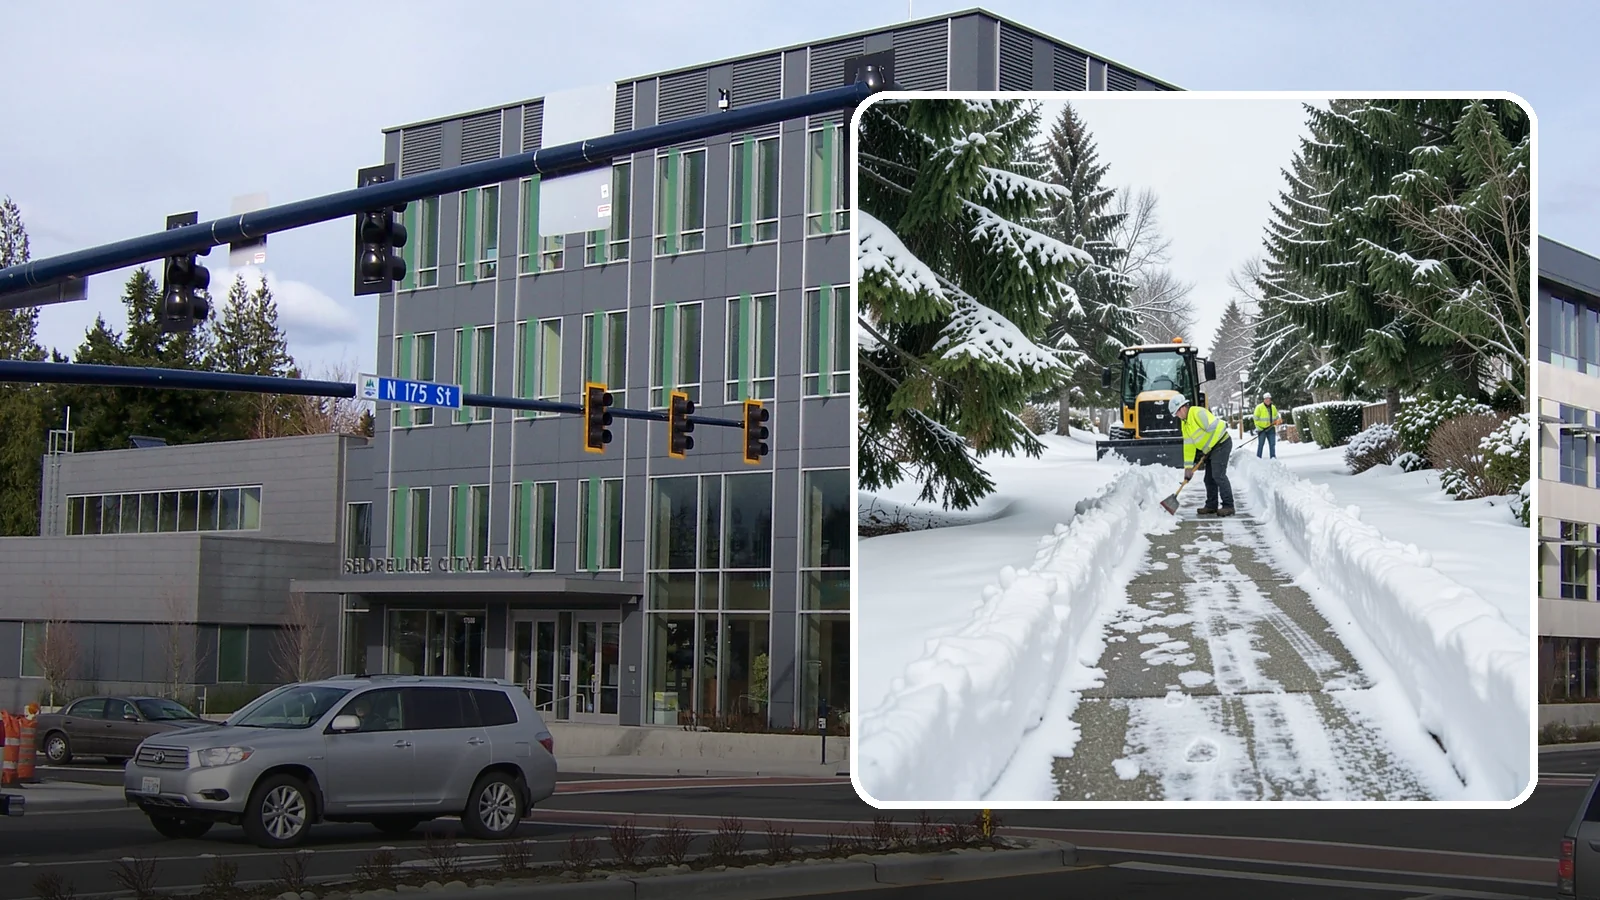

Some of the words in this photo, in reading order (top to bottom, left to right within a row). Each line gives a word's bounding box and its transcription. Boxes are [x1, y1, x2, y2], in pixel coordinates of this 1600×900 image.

[387, 380, 396, 399] N
[405, 382, 428, 403] 175
[436, 386, 452, 406] St
[343, 557, 432, 574] SHORELINE
[438, 556, 475, 573] CITY
[484, 555, 525, 571] HALL
